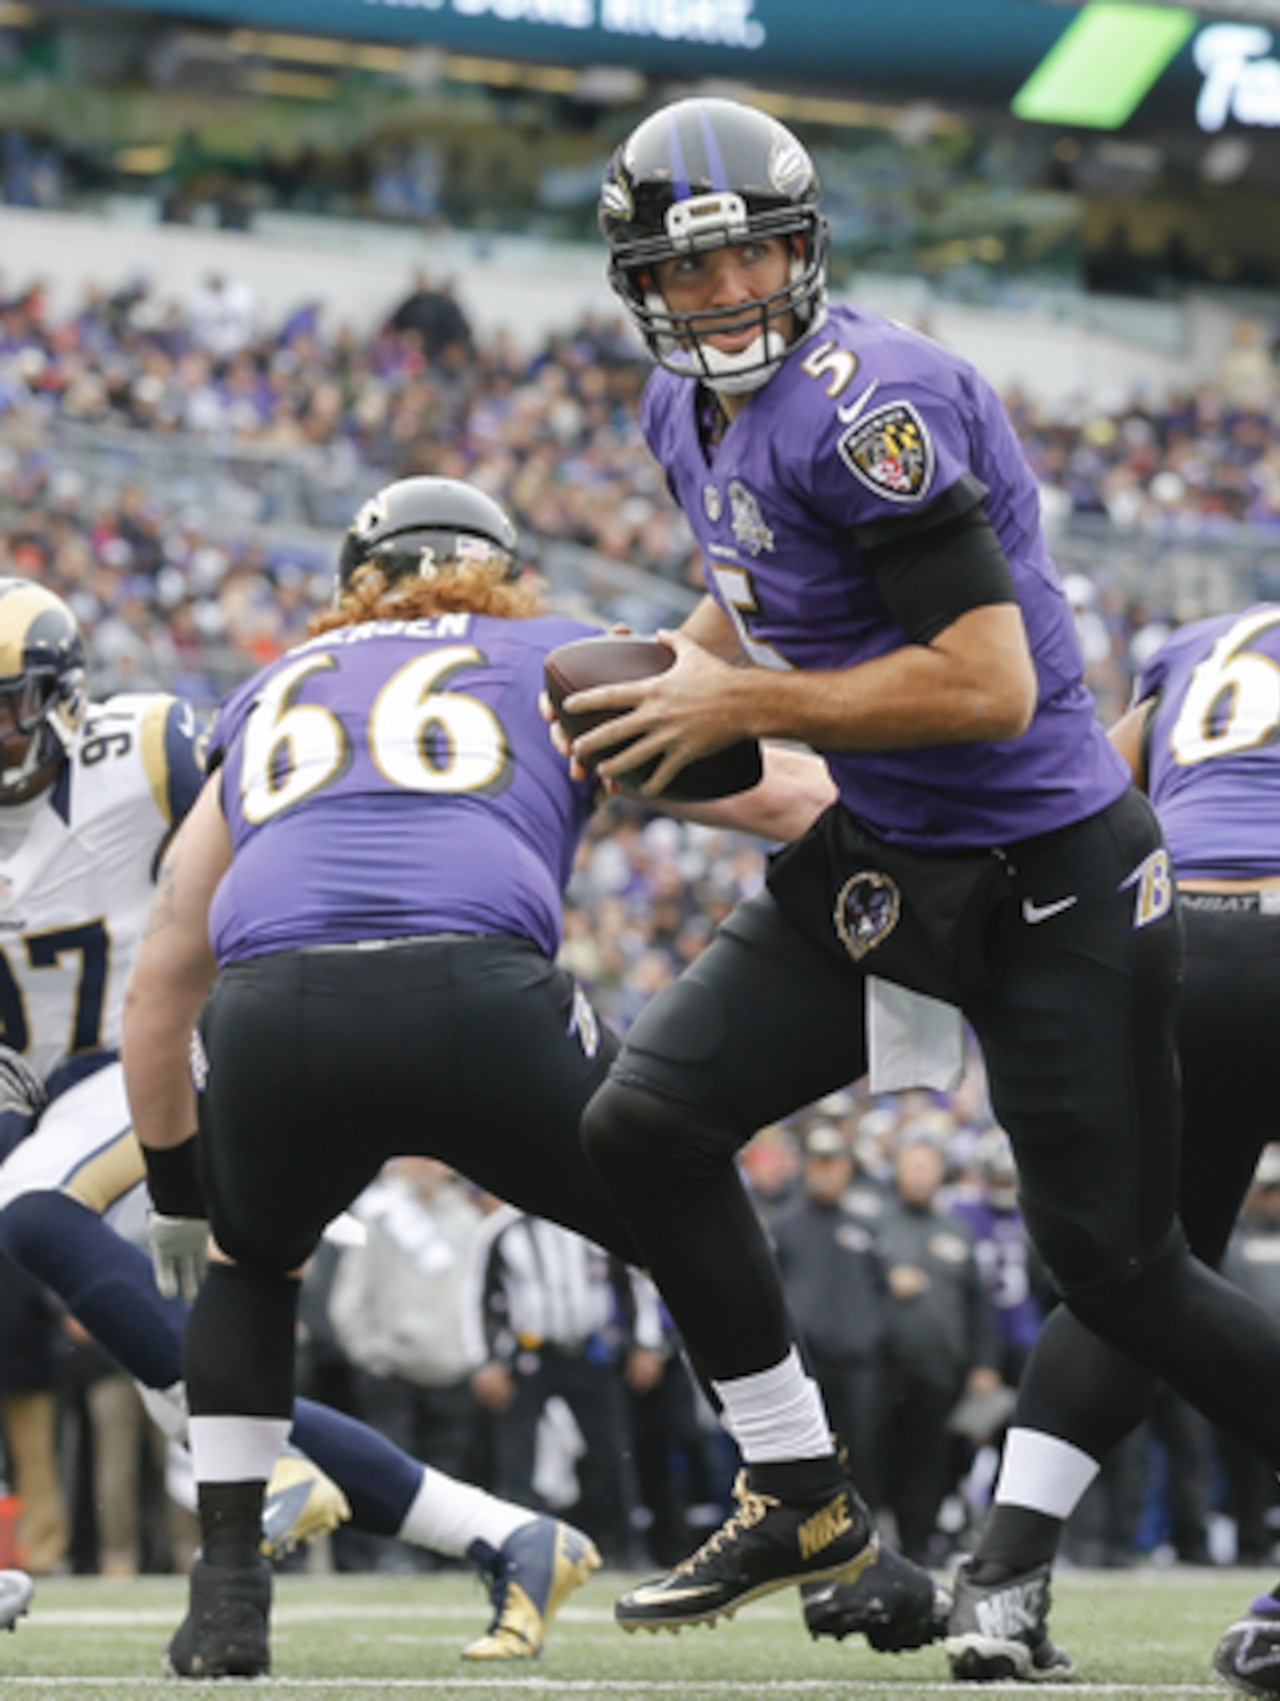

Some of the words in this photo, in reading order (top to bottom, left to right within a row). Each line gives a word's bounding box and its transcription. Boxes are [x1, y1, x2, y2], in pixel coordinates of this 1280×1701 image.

[801, 340, 860, 397] 5
[80, 713, 134, 767] 97
[241, 645, 506, 825] 66
[798, 1493, 853, 1560] NIKE
